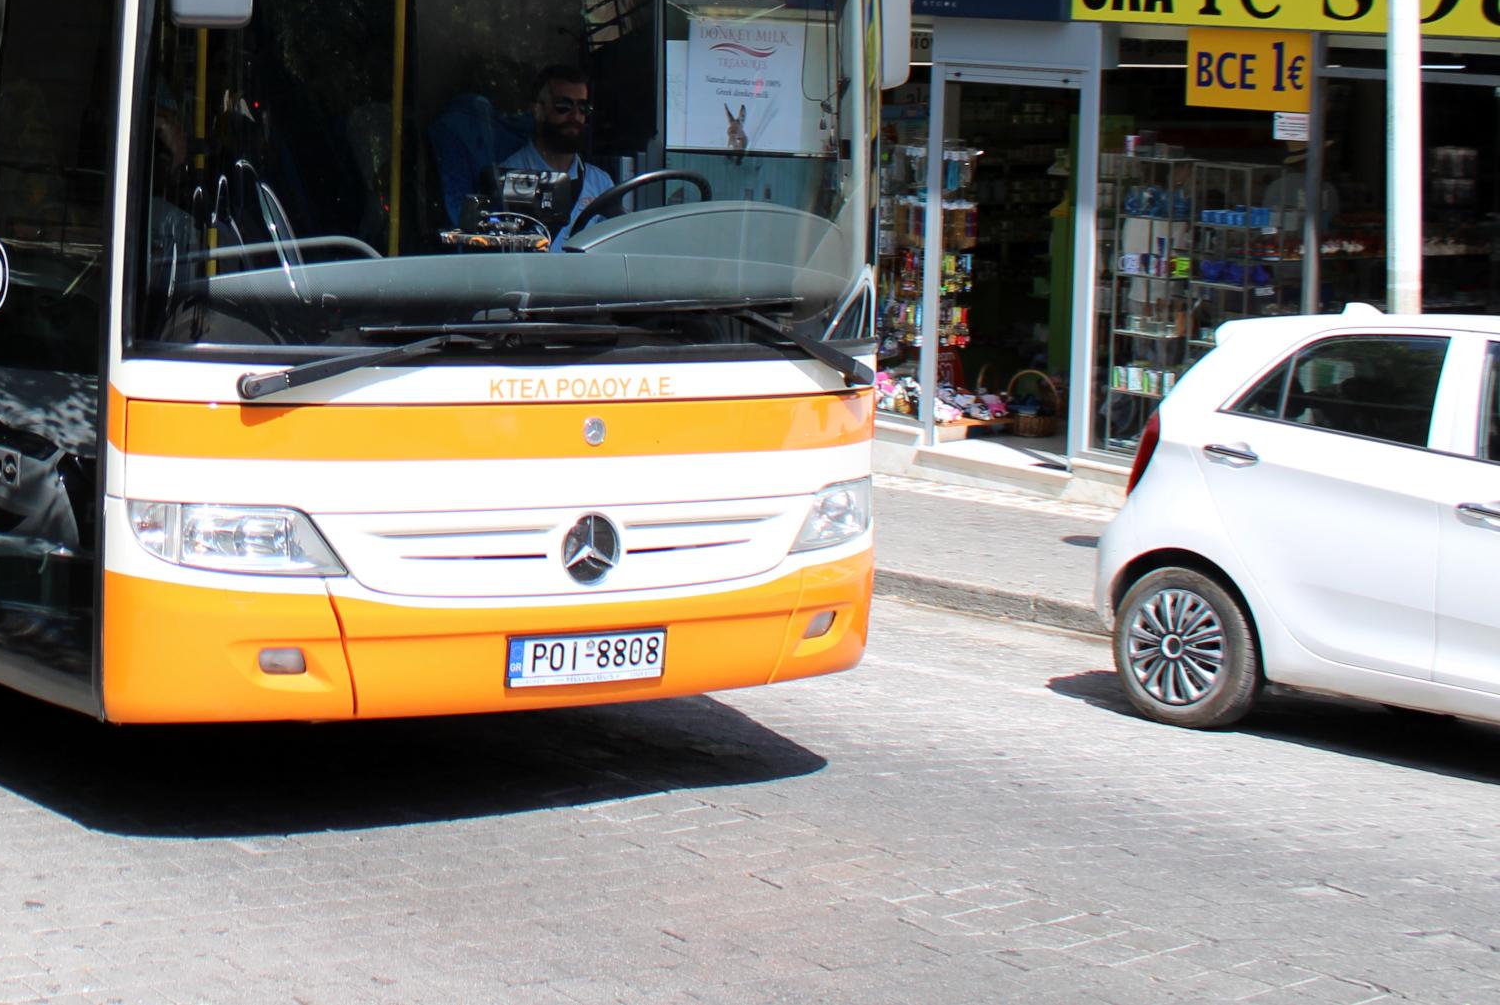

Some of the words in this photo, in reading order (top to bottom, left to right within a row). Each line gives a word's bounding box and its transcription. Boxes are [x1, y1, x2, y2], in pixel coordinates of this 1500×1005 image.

[700, 25, 750, 43] DONKEY
[756, 30, 793, 46] MILK
[717, 57, 768, 70] TREASURES
[1196, 51, 1256, 90] ВСЕ
[1272, 42, 1305, 92] 1€
[489, 379, 549, 399] ΚΤΕΛ
[556, 377, 632, 398] ΡΟΔΟΥ
[637, 376, 675, 397] Α.Ε.
[510, 662, 522, 672] GR
